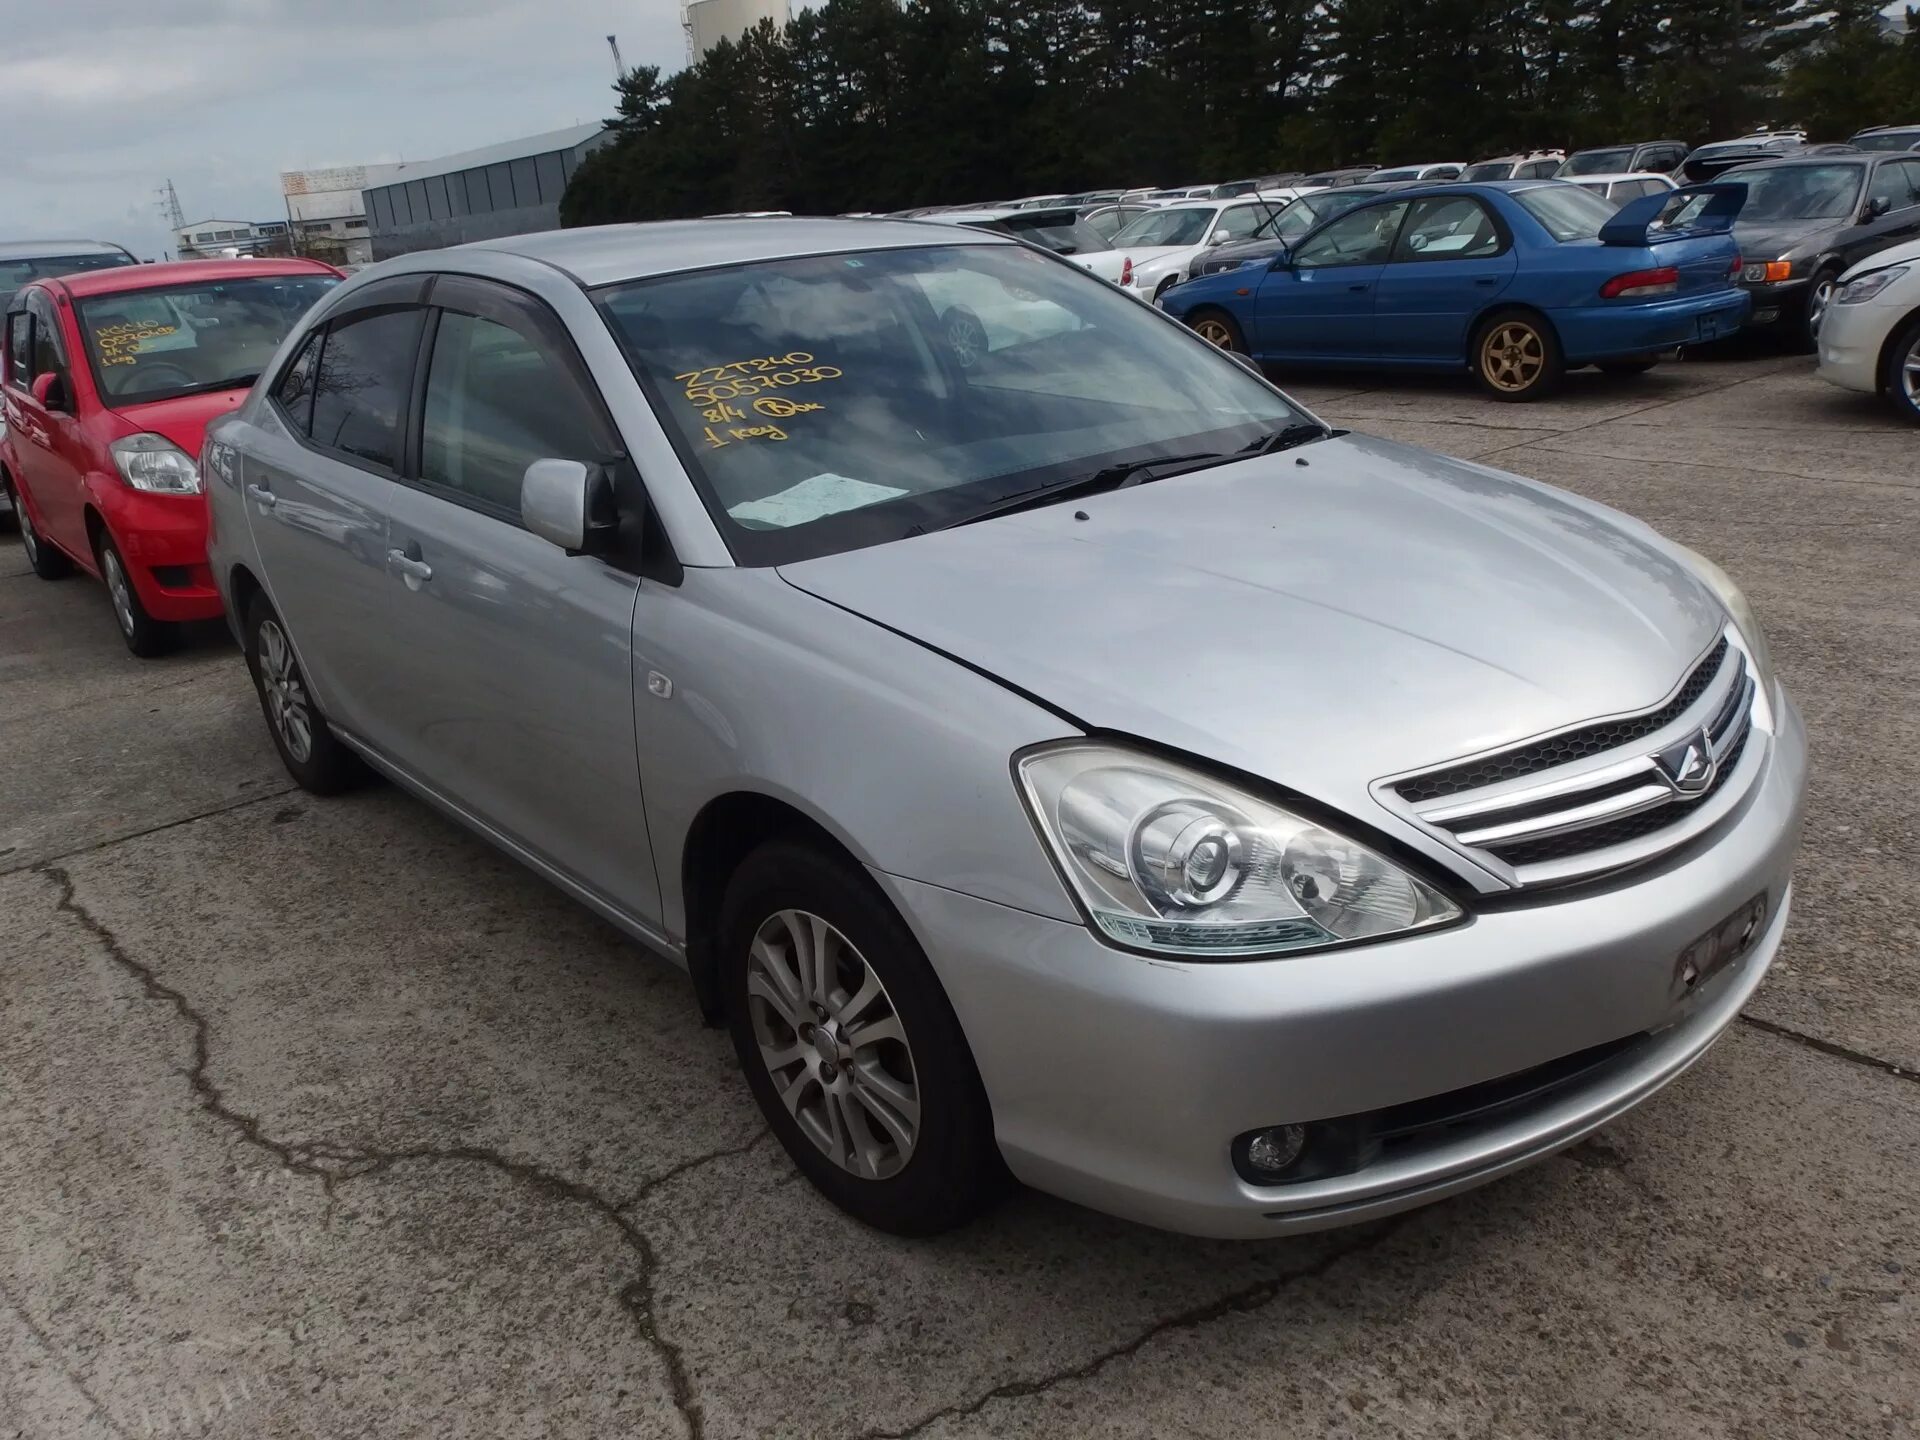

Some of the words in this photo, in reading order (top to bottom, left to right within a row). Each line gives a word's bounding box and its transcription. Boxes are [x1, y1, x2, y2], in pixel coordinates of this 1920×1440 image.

[674, 352, 815, 388] ZZT240
[684, 366, 843, 407] 5057030
[702, 402, 747, 424] 8/4
[703, 426, 731, 450] 1
